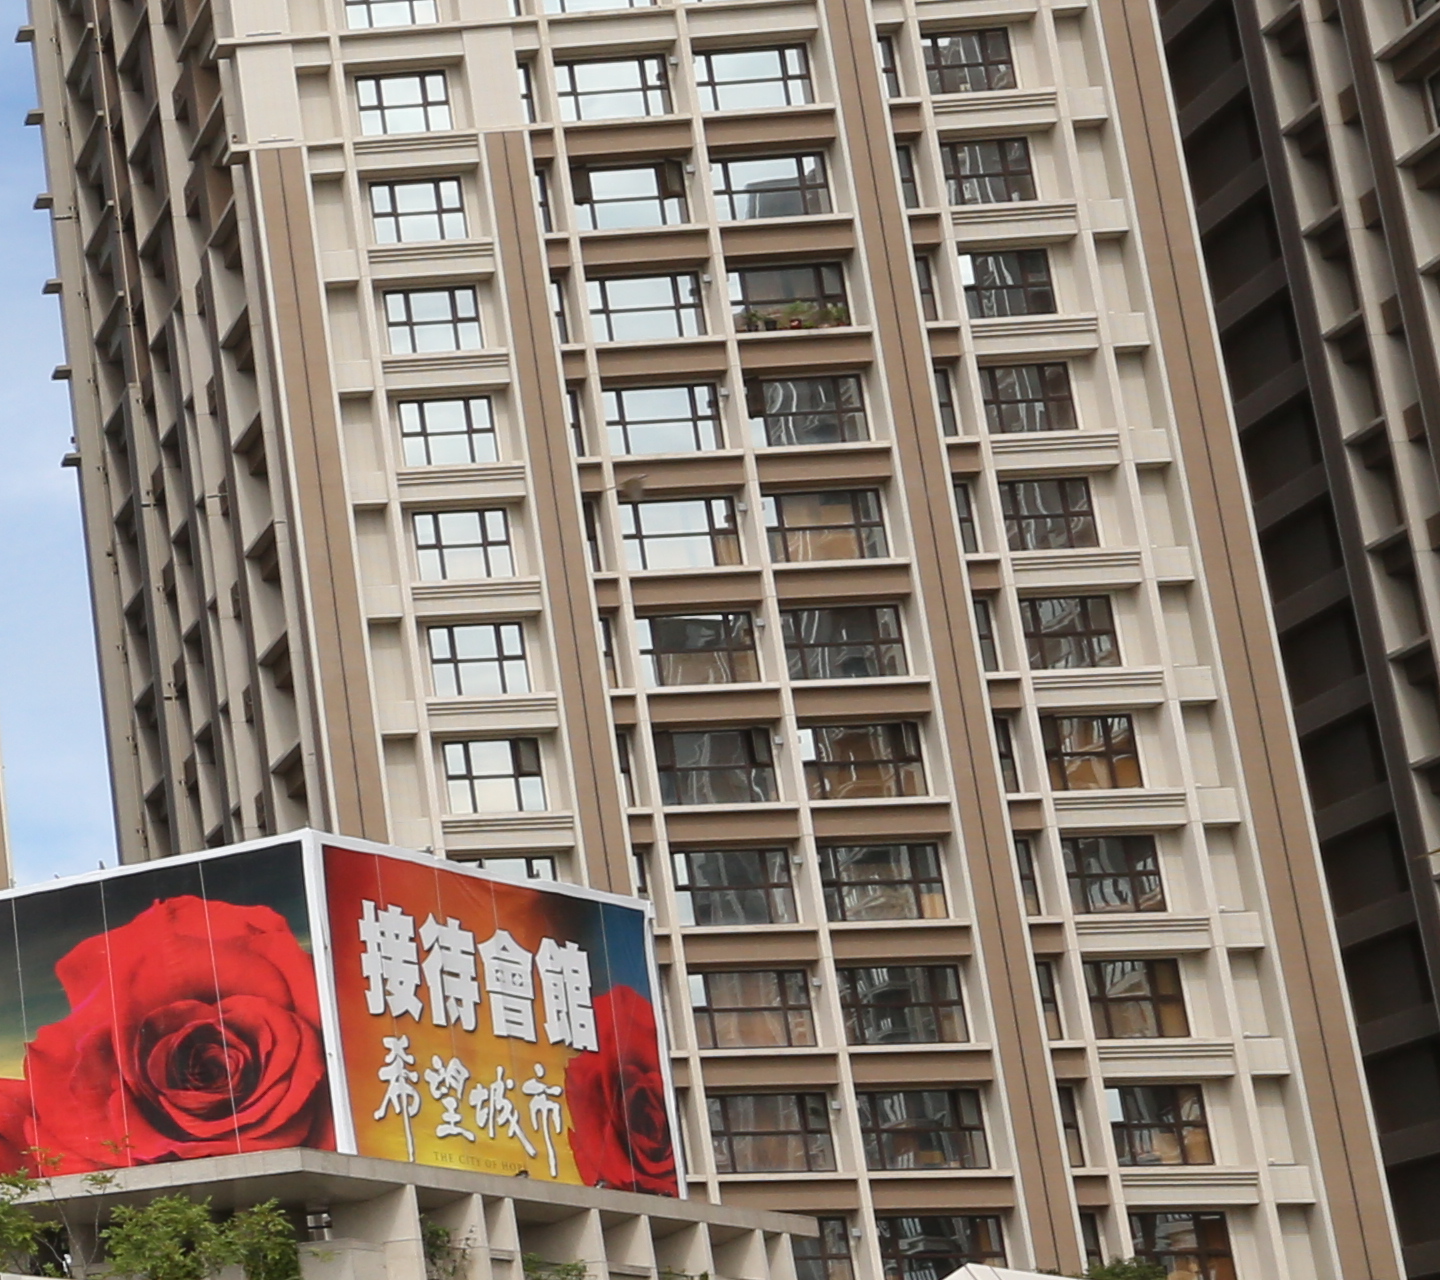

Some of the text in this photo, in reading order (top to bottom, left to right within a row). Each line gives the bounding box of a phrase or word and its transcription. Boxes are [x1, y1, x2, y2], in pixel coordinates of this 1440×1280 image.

[357, 899, 599, 1052] 接待會館
[373, 1034, 563, 1177] 希望城市
[433, 1151, 453, 1162] THE
[458, 1154, 481, 1167] CITY
